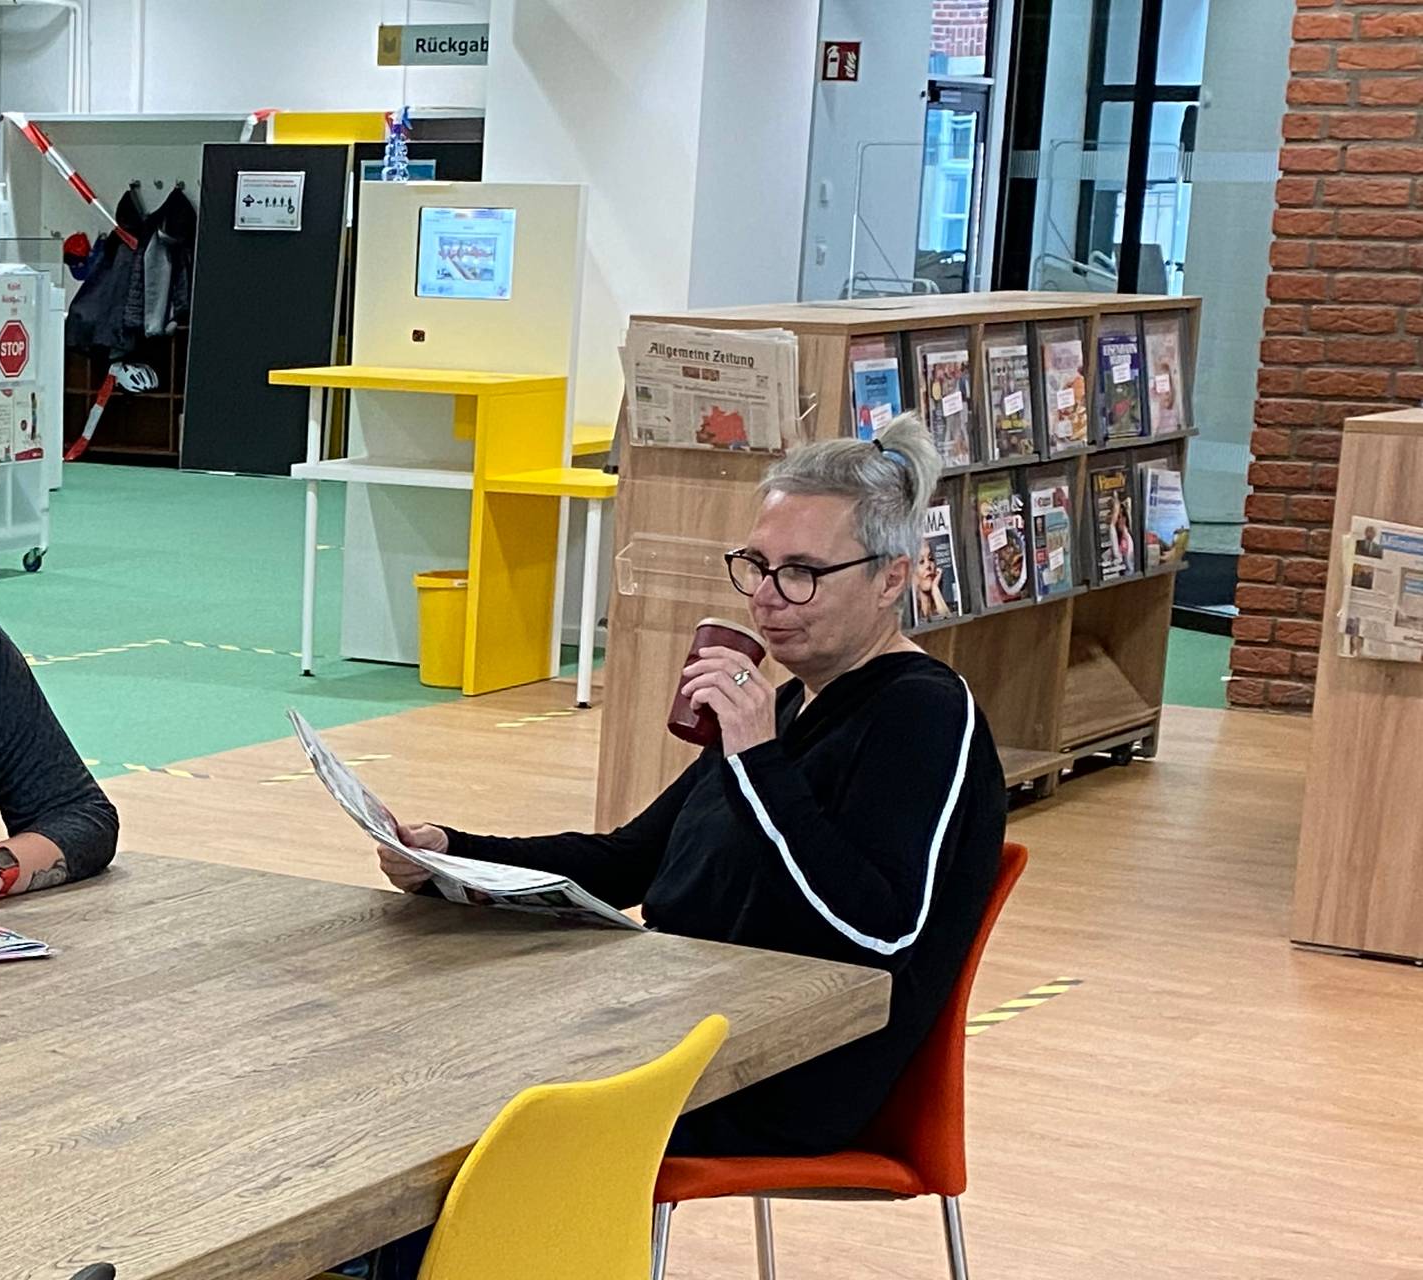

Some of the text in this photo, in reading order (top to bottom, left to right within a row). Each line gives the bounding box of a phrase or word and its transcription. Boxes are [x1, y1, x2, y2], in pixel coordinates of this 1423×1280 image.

[415, 37, 489, 56] Rückgab
[0, 341, 25, 357] STOP
[648, 342, 755, 367] Allgemeine Zeitung
